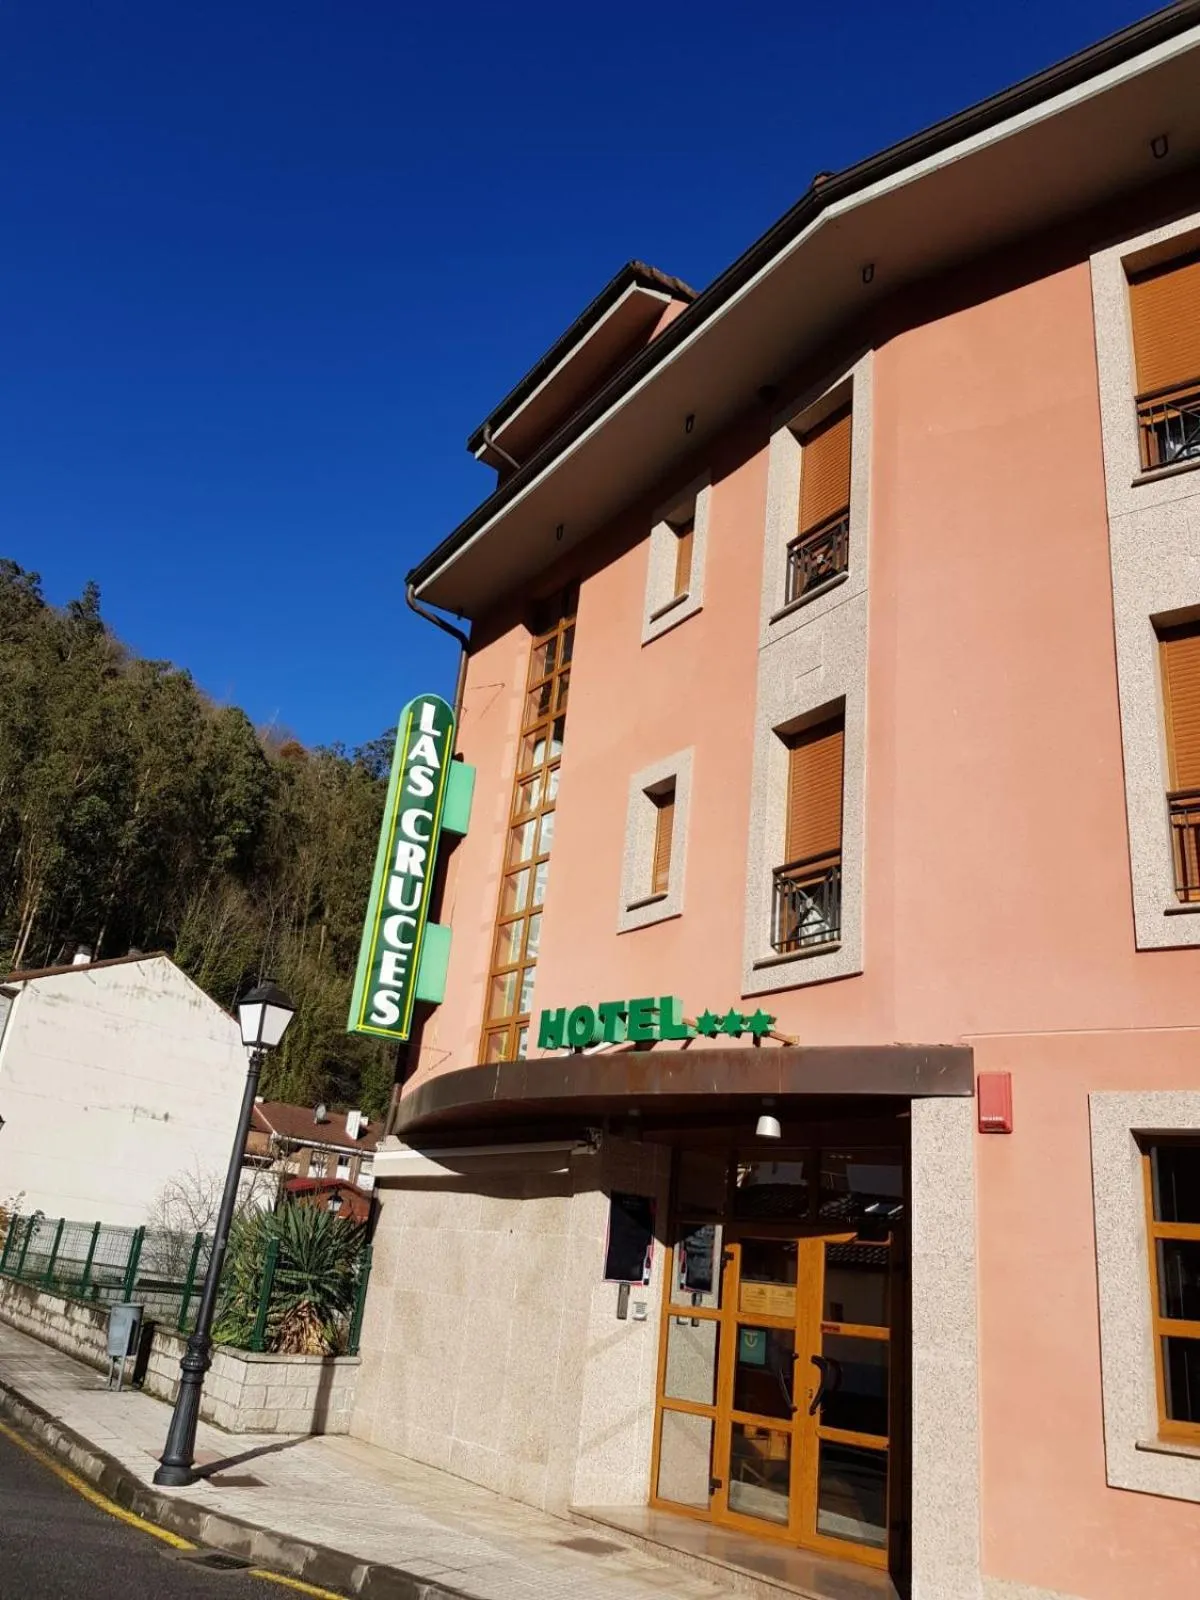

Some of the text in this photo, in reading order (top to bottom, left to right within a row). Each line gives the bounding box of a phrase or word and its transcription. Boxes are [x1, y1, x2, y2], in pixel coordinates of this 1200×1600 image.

[370, 702, 441, 1026] LAS CRUCES
[537, 996, 693, 1049] HOTEL
